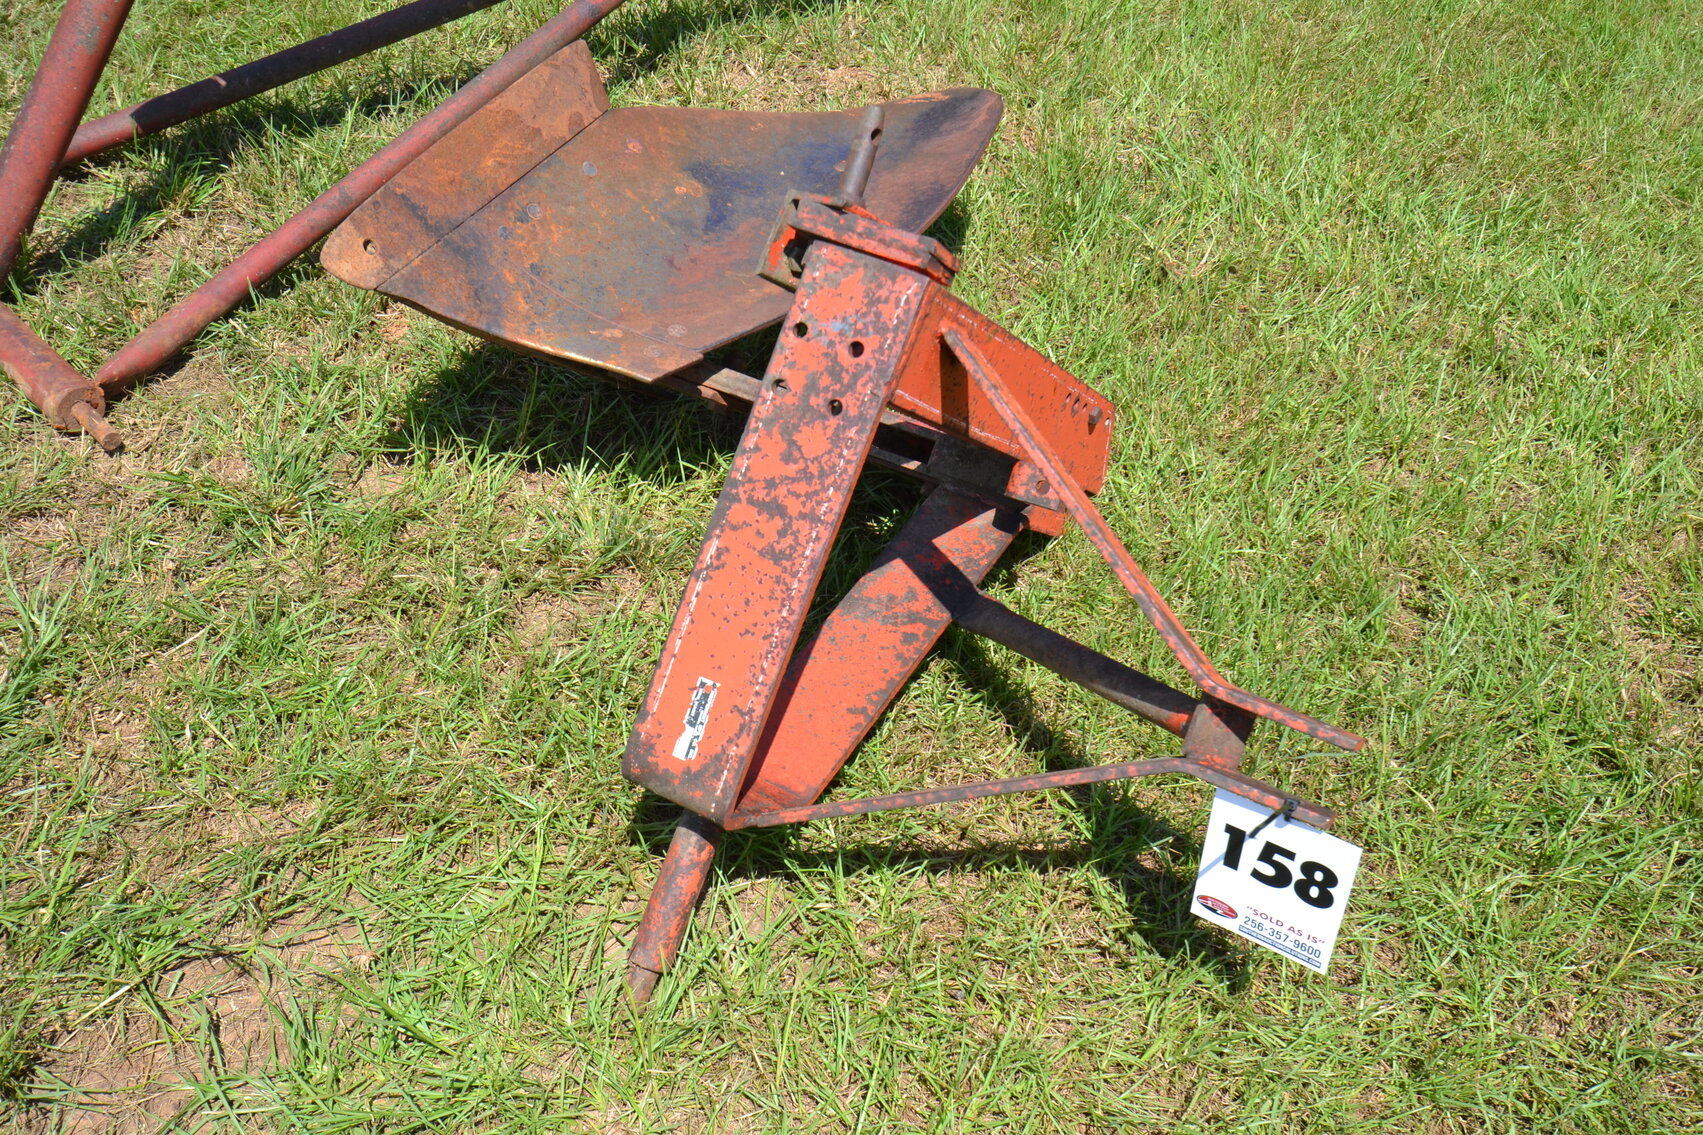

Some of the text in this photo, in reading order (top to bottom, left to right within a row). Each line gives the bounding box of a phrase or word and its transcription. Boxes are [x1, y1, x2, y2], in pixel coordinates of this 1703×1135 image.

[1223, 823, 1339, 909] 158
[1243, 916, 1321, 958] 256-357-9600
[1287, 925, 1303, 937] AS
